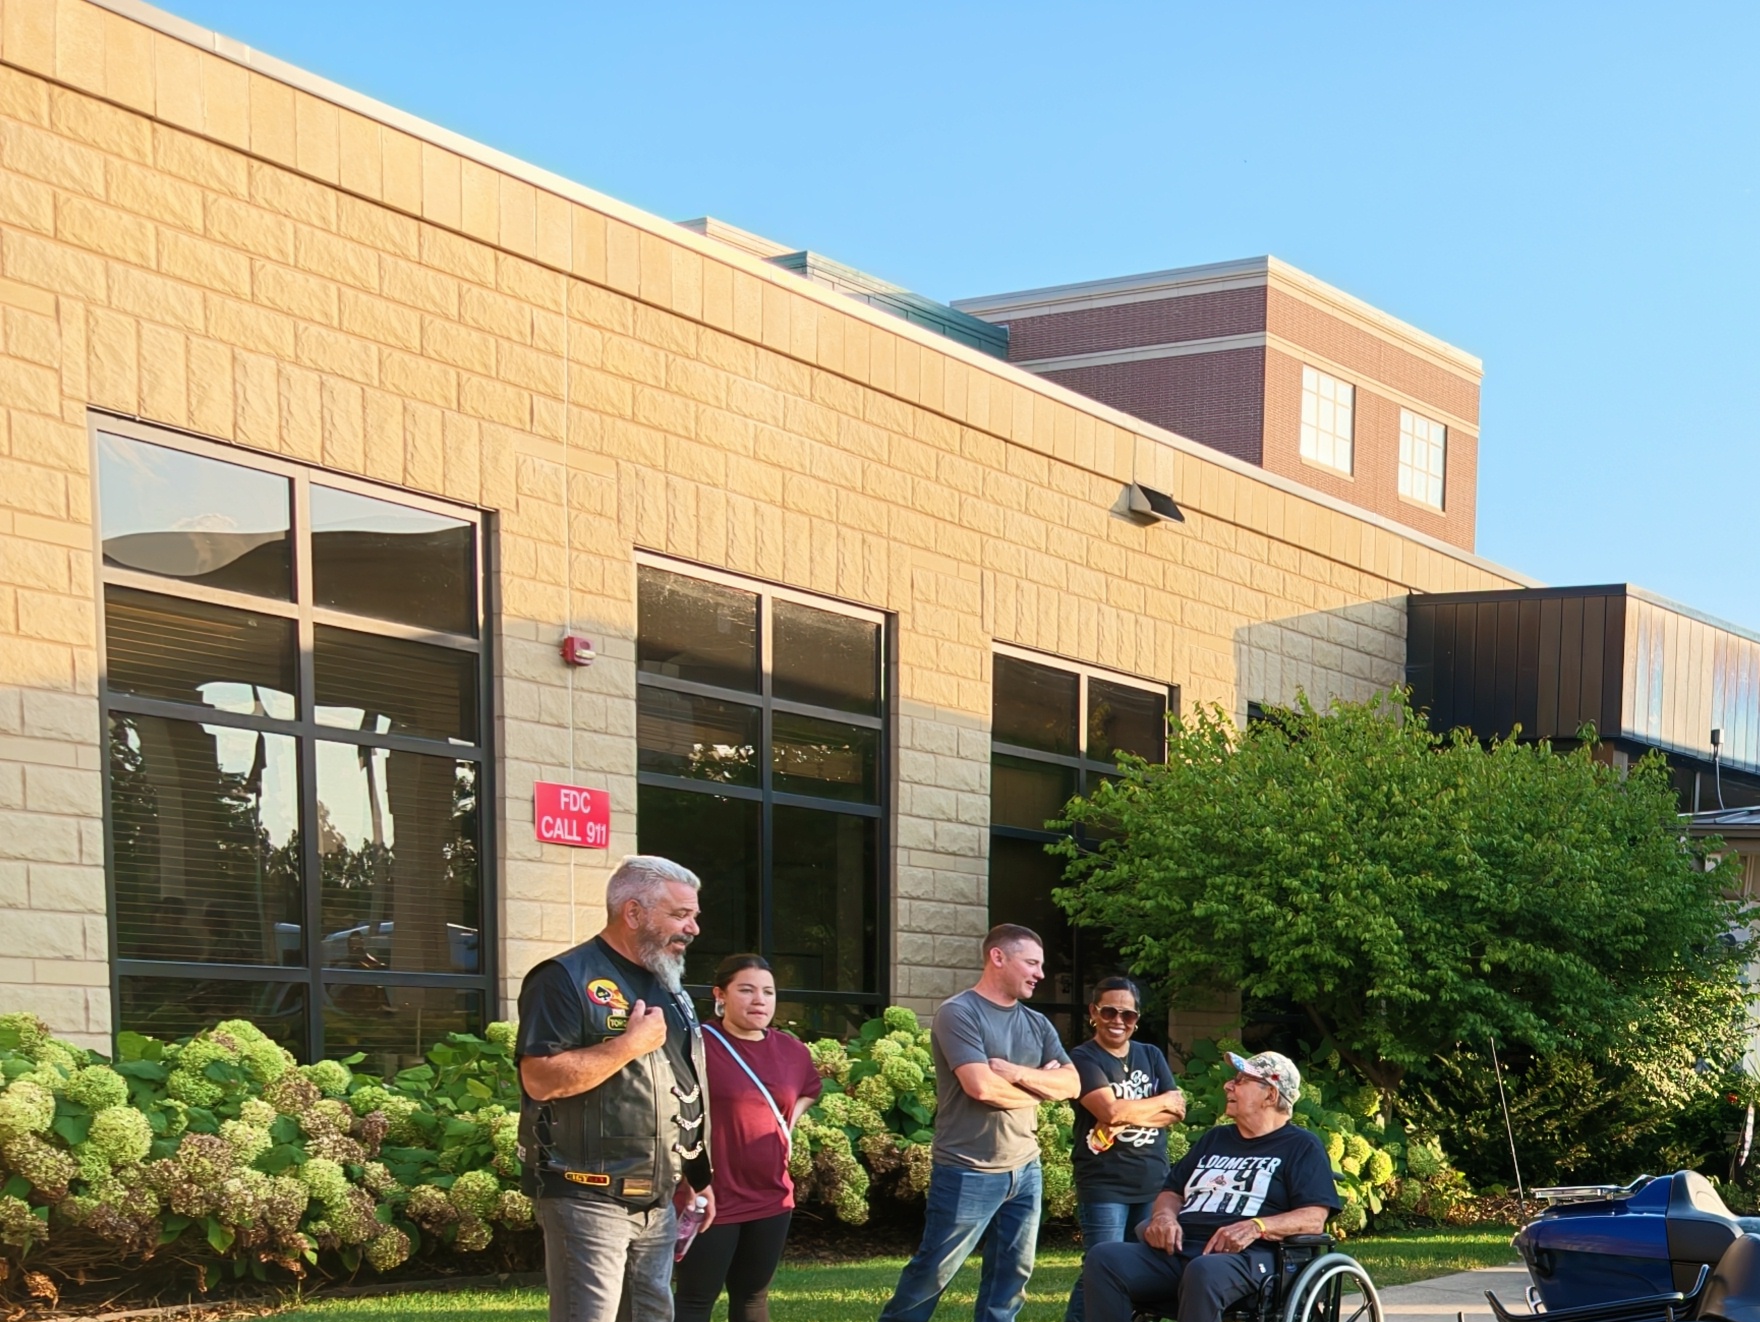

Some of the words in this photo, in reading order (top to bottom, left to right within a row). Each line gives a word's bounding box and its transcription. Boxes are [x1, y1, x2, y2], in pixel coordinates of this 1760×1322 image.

[560, 788, 591, 814] FDC
[541, 815, 582, 842] CALL
[586, 821, 607, 845] 911
[1130, 1069, 1150, 1089] Be
[1196, 1154, 1282, 1174] LDOMETER
